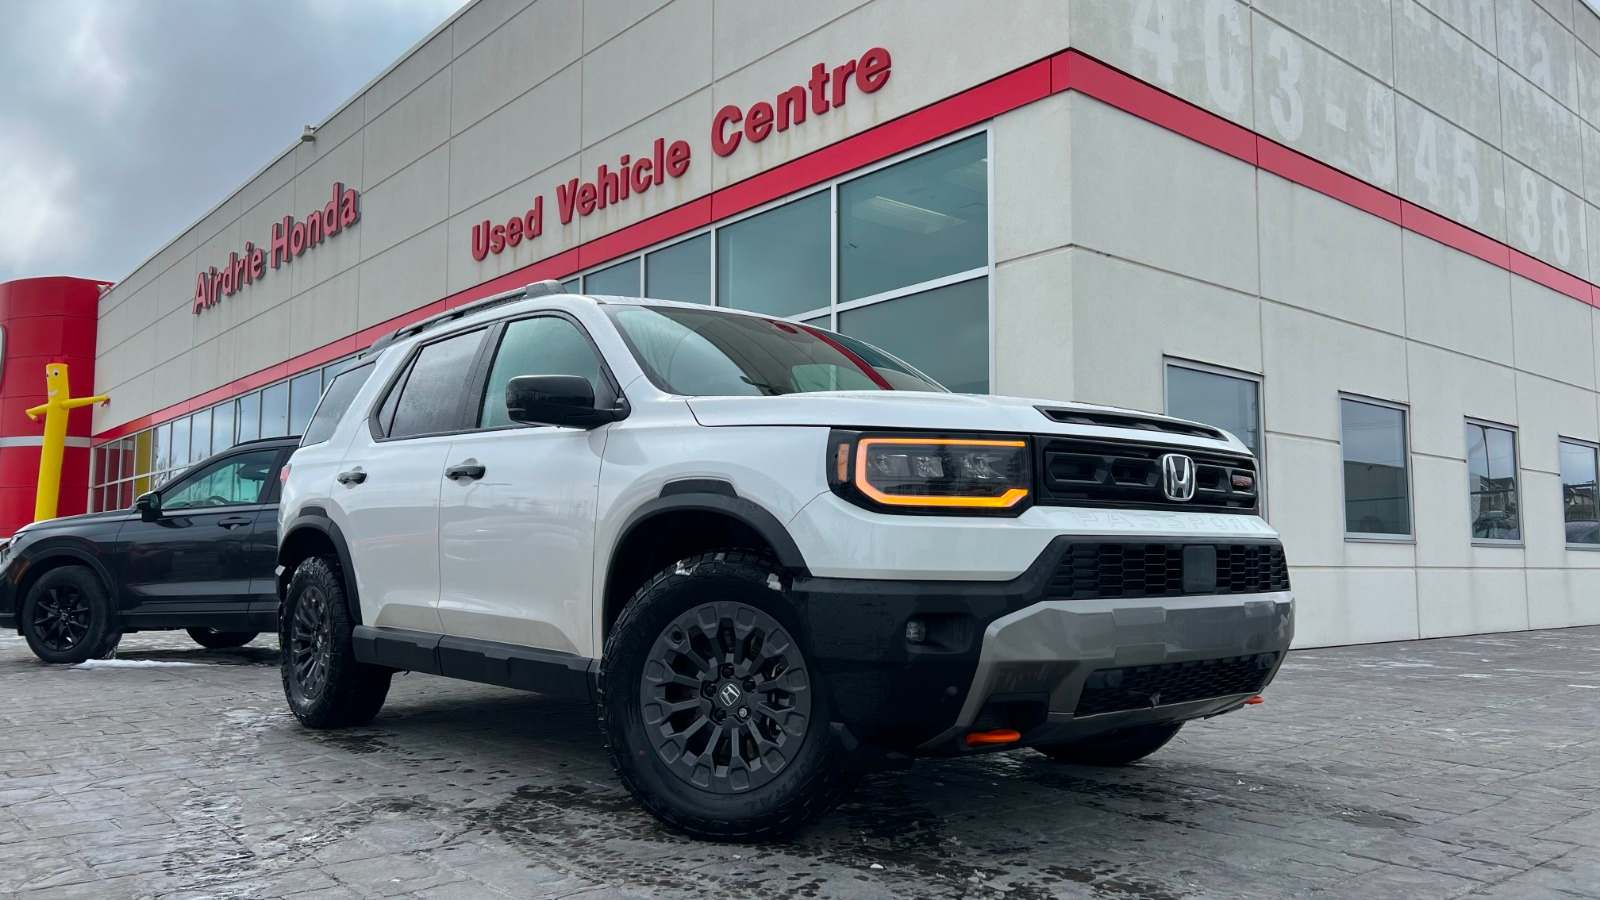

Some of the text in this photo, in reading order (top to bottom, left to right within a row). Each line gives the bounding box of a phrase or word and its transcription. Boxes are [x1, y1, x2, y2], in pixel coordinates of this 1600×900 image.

[472, 47, 892, 261] Used Vehicle Centre
[193, 182, 361, 314] Airdrie Honda
